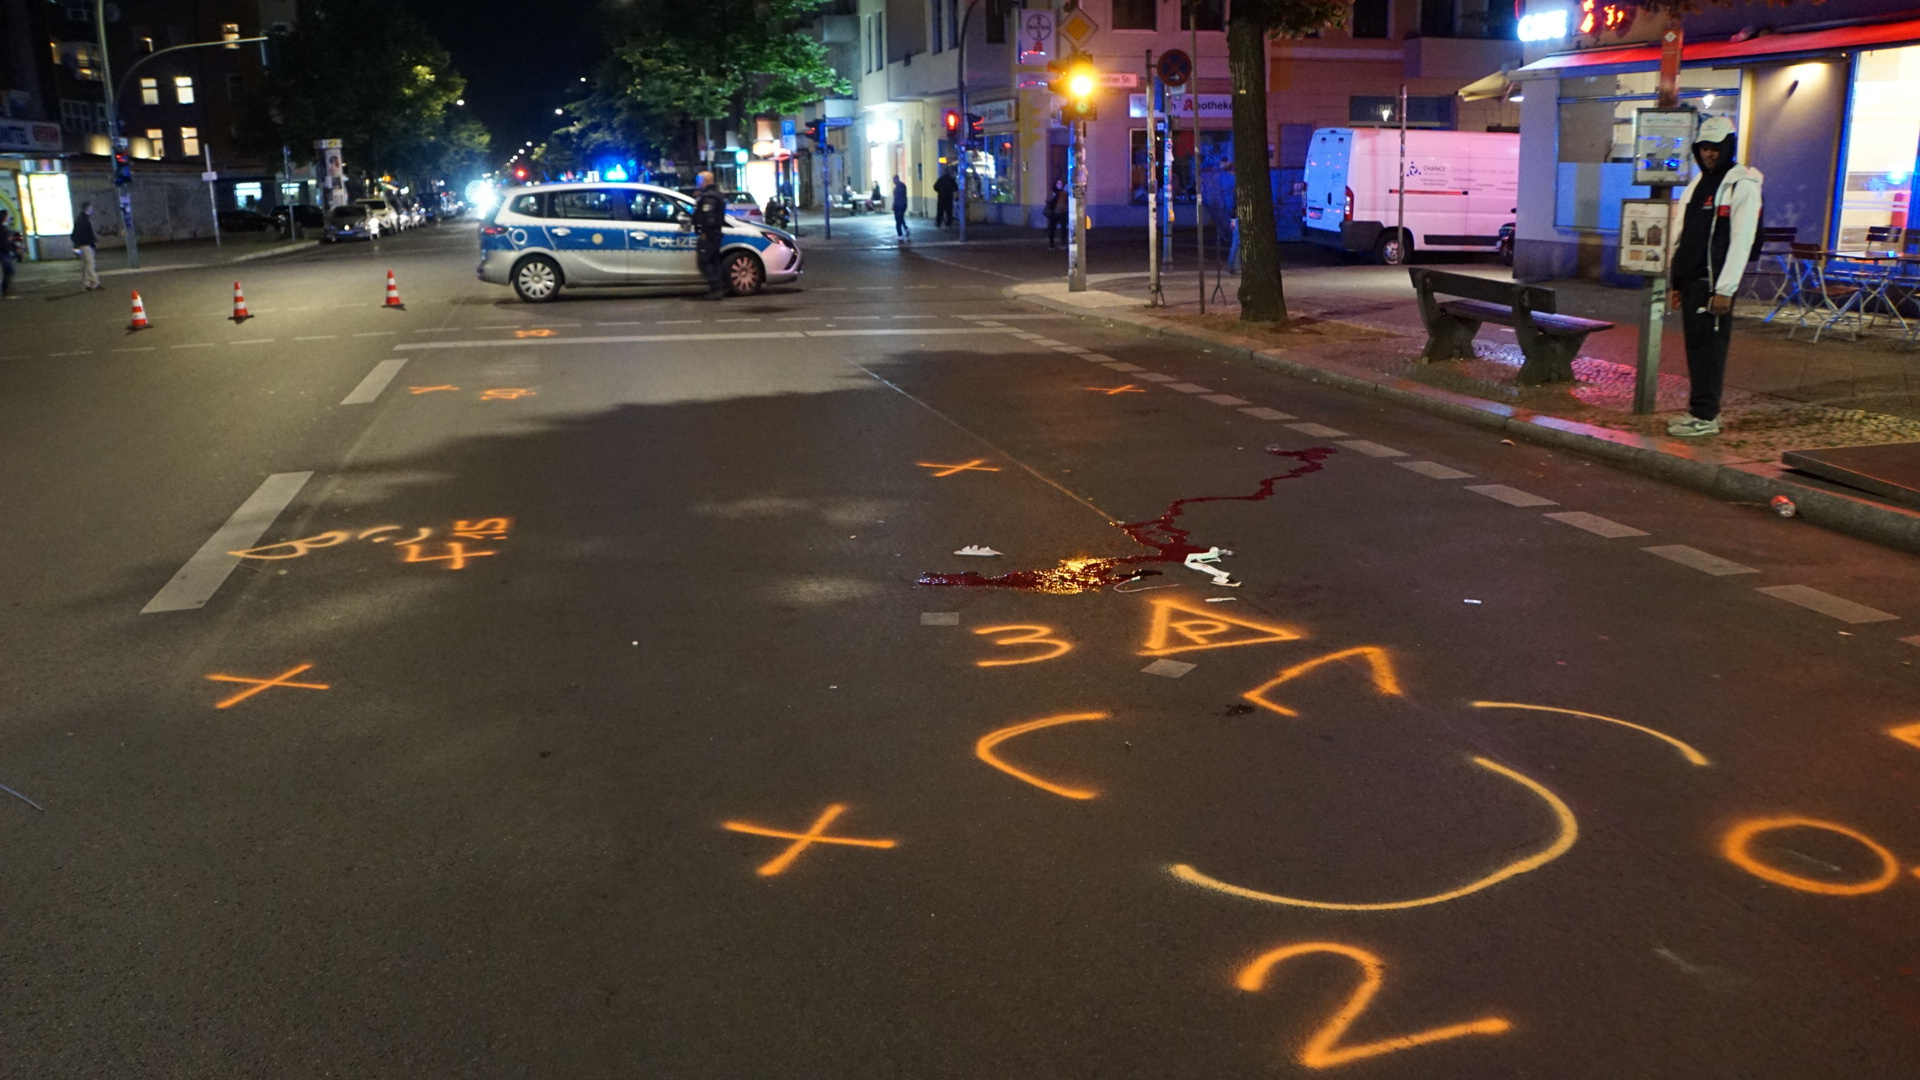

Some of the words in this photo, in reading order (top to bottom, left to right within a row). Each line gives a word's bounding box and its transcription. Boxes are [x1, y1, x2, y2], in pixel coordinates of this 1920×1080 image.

[648, 235, 698, 248] POLIZE
[973, 624, 1073, 669] 3
[1236, 942, 1511, 1069] 2
